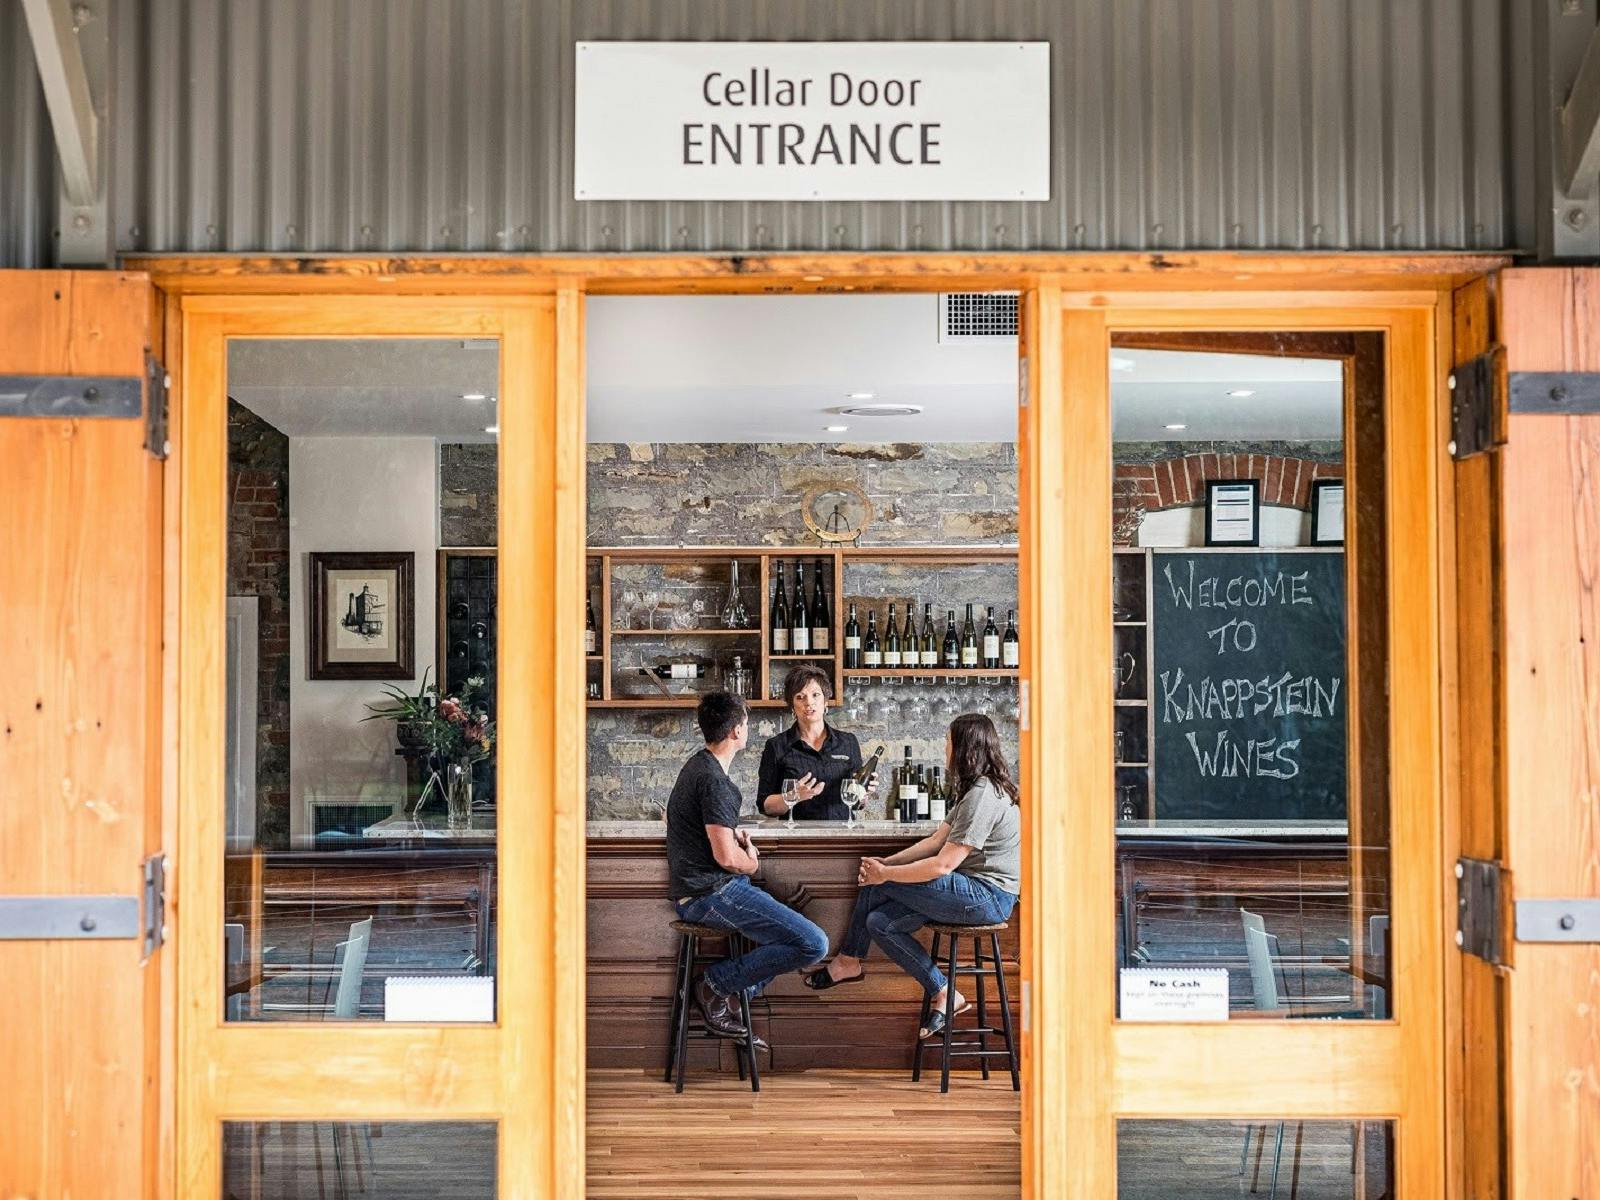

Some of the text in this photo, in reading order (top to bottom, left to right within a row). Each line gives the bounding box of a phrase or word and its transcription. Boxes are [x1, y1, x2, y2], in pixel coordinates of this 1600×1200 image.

[703, 68, 922, 107] Cellar Door
[683, 123, 941, 165] ENTRANCE
[1163, 560, 1313, 610] WELCOME
[1207, 617, 1257, 655] TO
[1160, 667, 1341, 723] KNAPPSTEIN
[1185, 730, 1301, 780] WINES
[1149, 980, 1201, 988] No Cash
